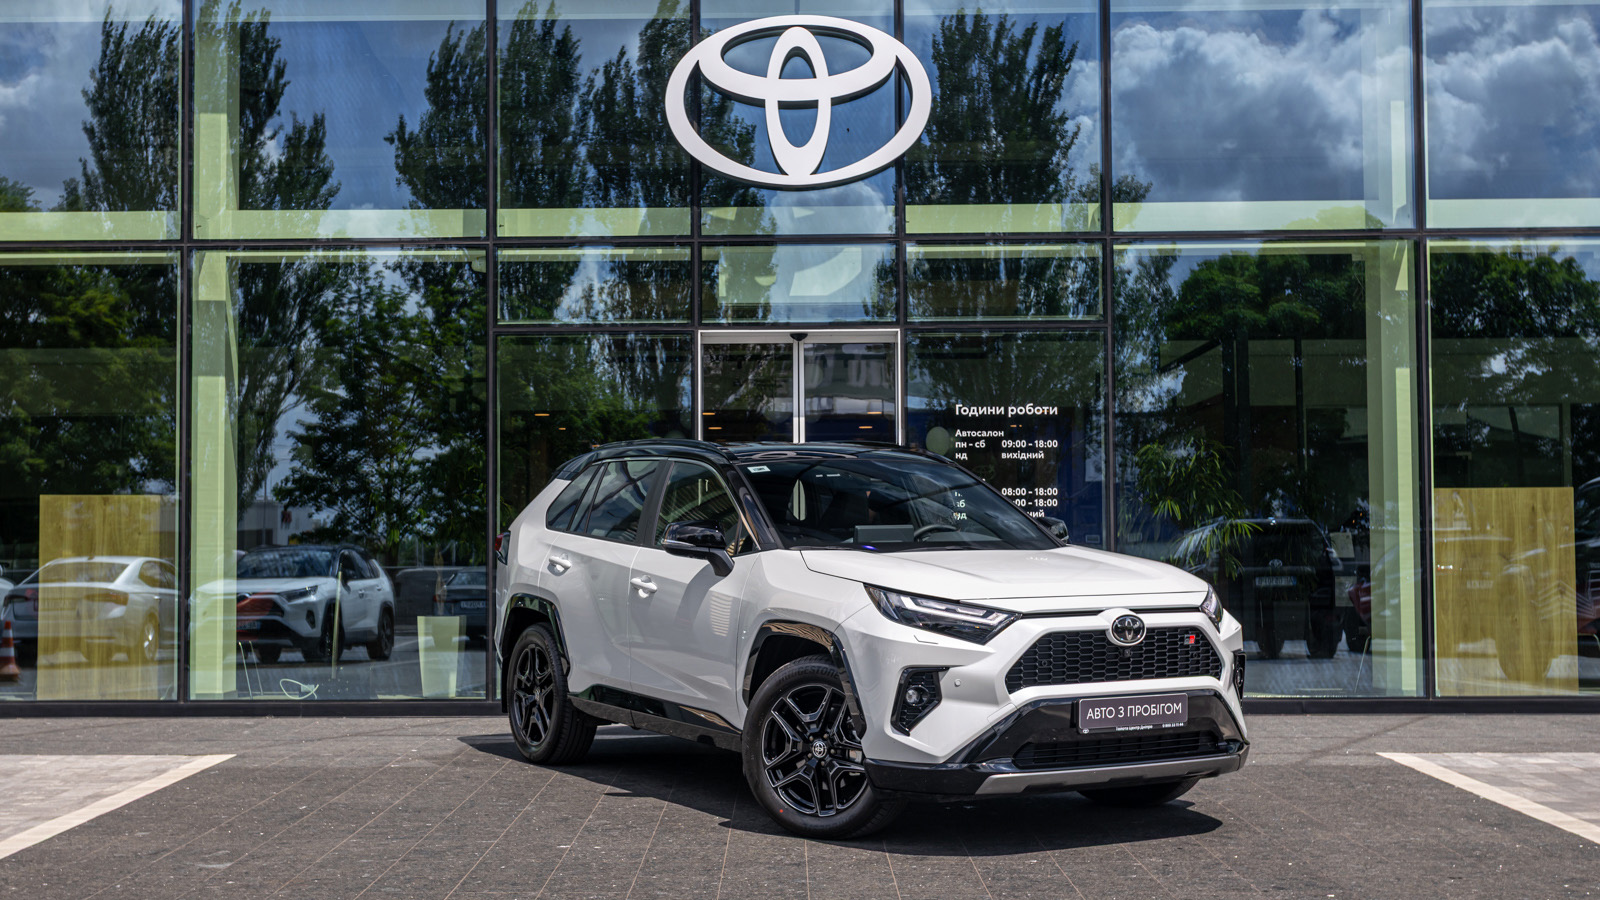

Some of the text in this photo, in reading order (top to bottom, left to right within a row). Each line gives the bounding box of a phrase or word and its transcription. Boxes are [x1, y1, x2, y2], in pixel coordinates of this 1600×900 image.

[955, 403, 1058, 418] Години роботи
[955, 429, 1005, 437] Автосалон
[974, 440, 986, 448] сб
[1001, 440, 1027, 448] 09:00
[1034, 440, 1058, 448] 18:00
[1001, 451, 1045, 460] вихідний
[1001, 488, 1027, 496] 08:00
[1034, 488, 1058, 496] 18:00
[1034, 499, 1058, 507] 18:00
[1086, 707, 1115, 720] АВТО
[1127, 702, 1182, 717] ПРОБІГОМ
